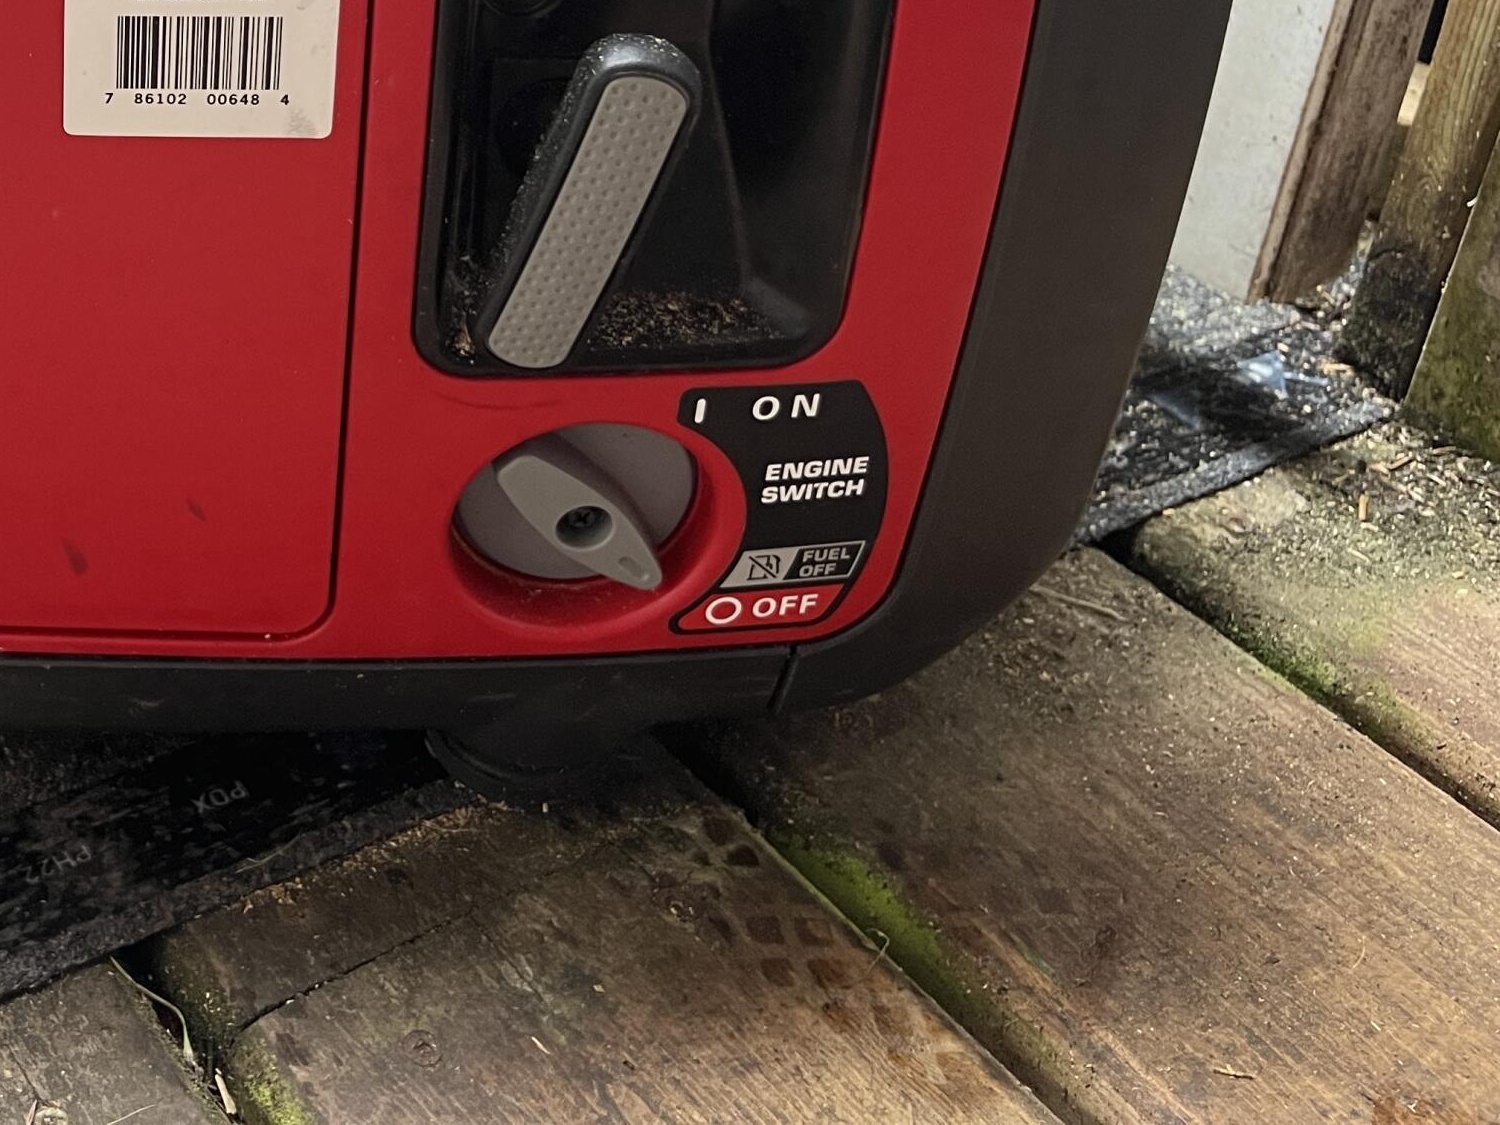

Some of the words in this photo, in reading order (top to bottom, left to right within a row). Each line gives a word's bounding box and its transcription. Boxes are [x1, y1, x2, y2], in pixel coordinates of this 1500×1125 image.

[105, 92, 114, 104] 7
[134, 92, 187, 105] 86102
[206, 93, 260, 105] 00648
[280, 94, 290, 106] 4
[752, 393, 821, 421] ON
[764, 456, 870, 482] ENGINE
[760, 478, 865, 504] SWITCH
[801, 547, 851, 562] FUEL
[798, 562, 838, 578] OFF
[752, 593, 819, 618] OFF
